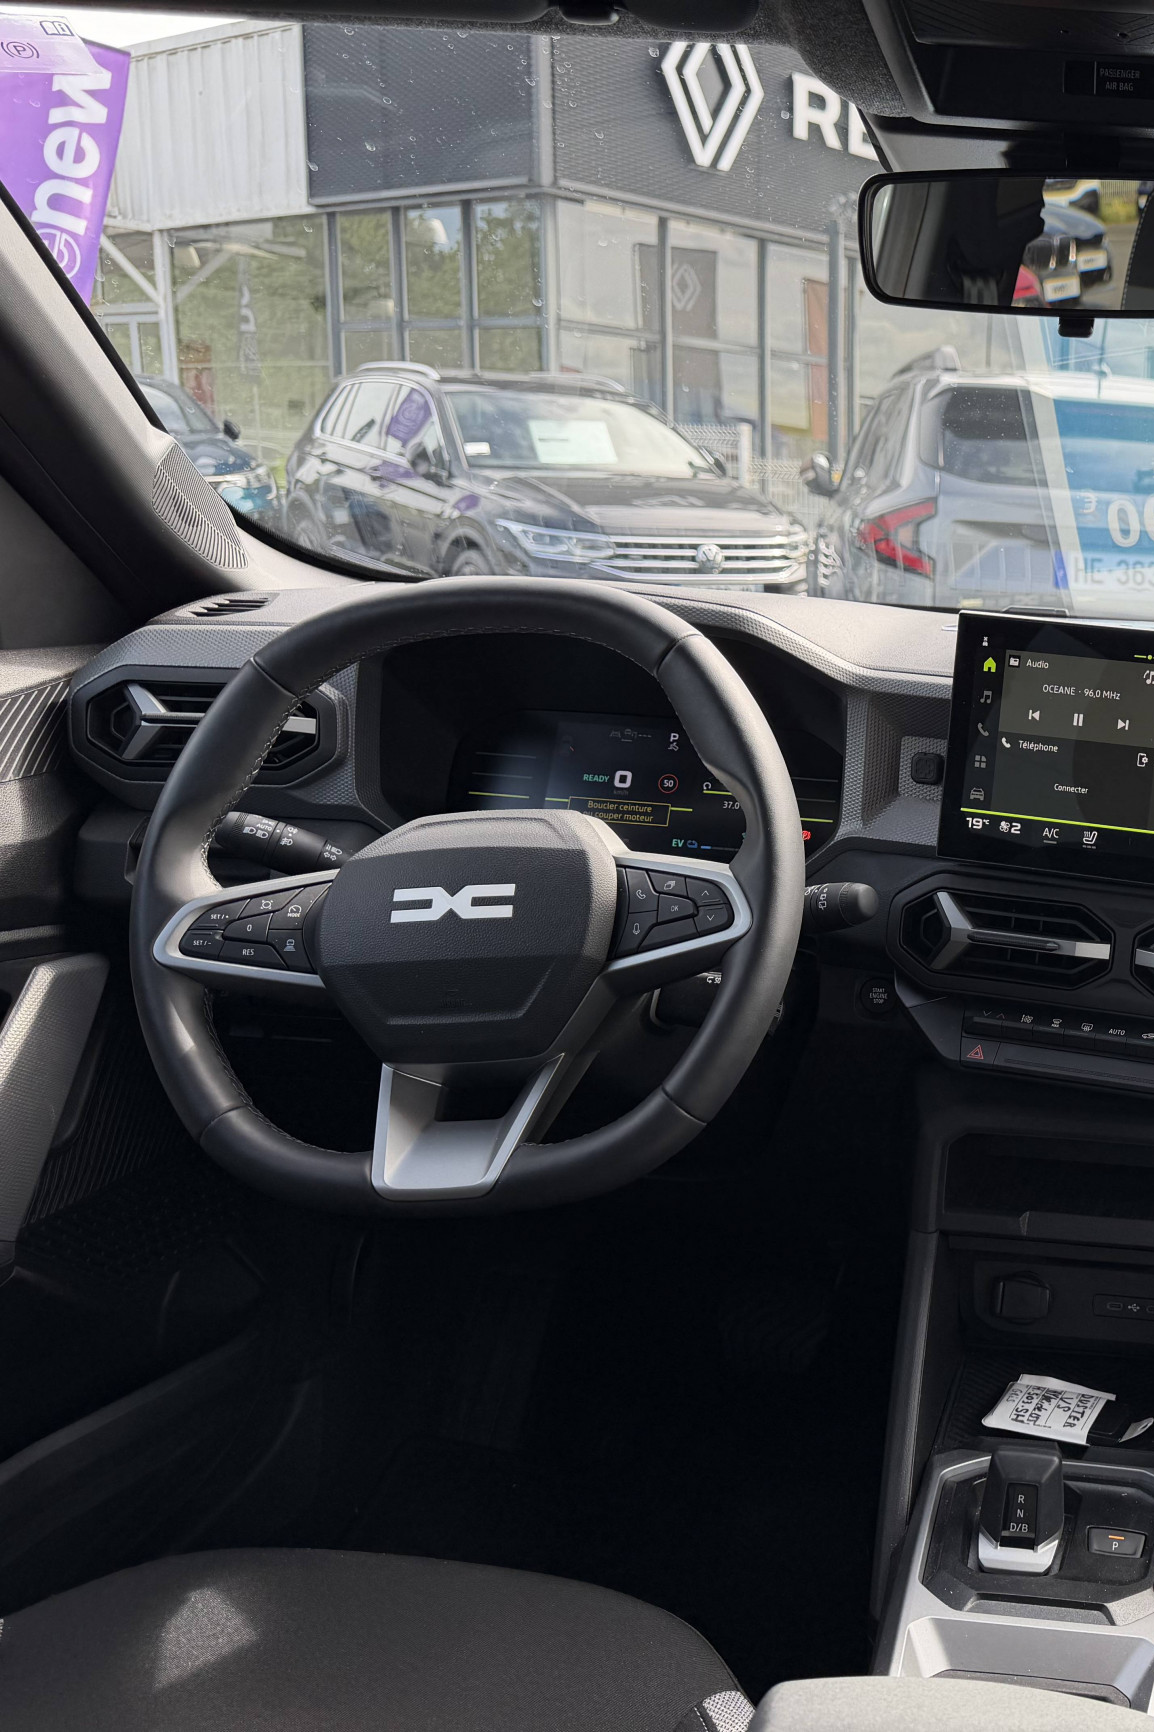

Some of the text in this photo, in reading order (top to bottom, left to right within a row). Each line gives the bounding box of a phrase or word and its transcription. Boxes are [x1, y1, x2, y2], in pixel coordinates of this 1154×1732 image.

[1099, 68, 1140, 79] PASSENGER
[1105, 81, 1134, 91] AIR BAG
[1025, 657, 1049, 670] Audio
[1042, 684, 1121, 702] OCEANE 96,0 MHz
[670, 733, 679, 742] P
[1018, 738, 1059, 754] Téléphone
[583, 770, 633, 789] READY 0
[663, 779, 674, 788] 50
[1053, 782, 1089, 795] Connecter
[587, 801, 653, 813] Boucler ceinture
[722, 801, 740, 810] 37.0
[594, 812, 622, 823] couper
[623, 814, 654, 823] moteur
[256, 823, 273, 831] AUTO
[1010, 822, 1022, 834] 2
[1042, 827, 1060, 838] A/C
[672, 839, 685, 848] EV
[670, 904, 679, 912] OK
[1108, 1028, 1126, 1036] AUTO
[1062, 1393, 1095, 1429] DUSTER
[1017, 1494, 1025, 1504] R
[1016, 1509, 1024, 1518] N
[1009, 1522, 1029, 1533] D/B
[1112, 1541, 1119, 1551] P
